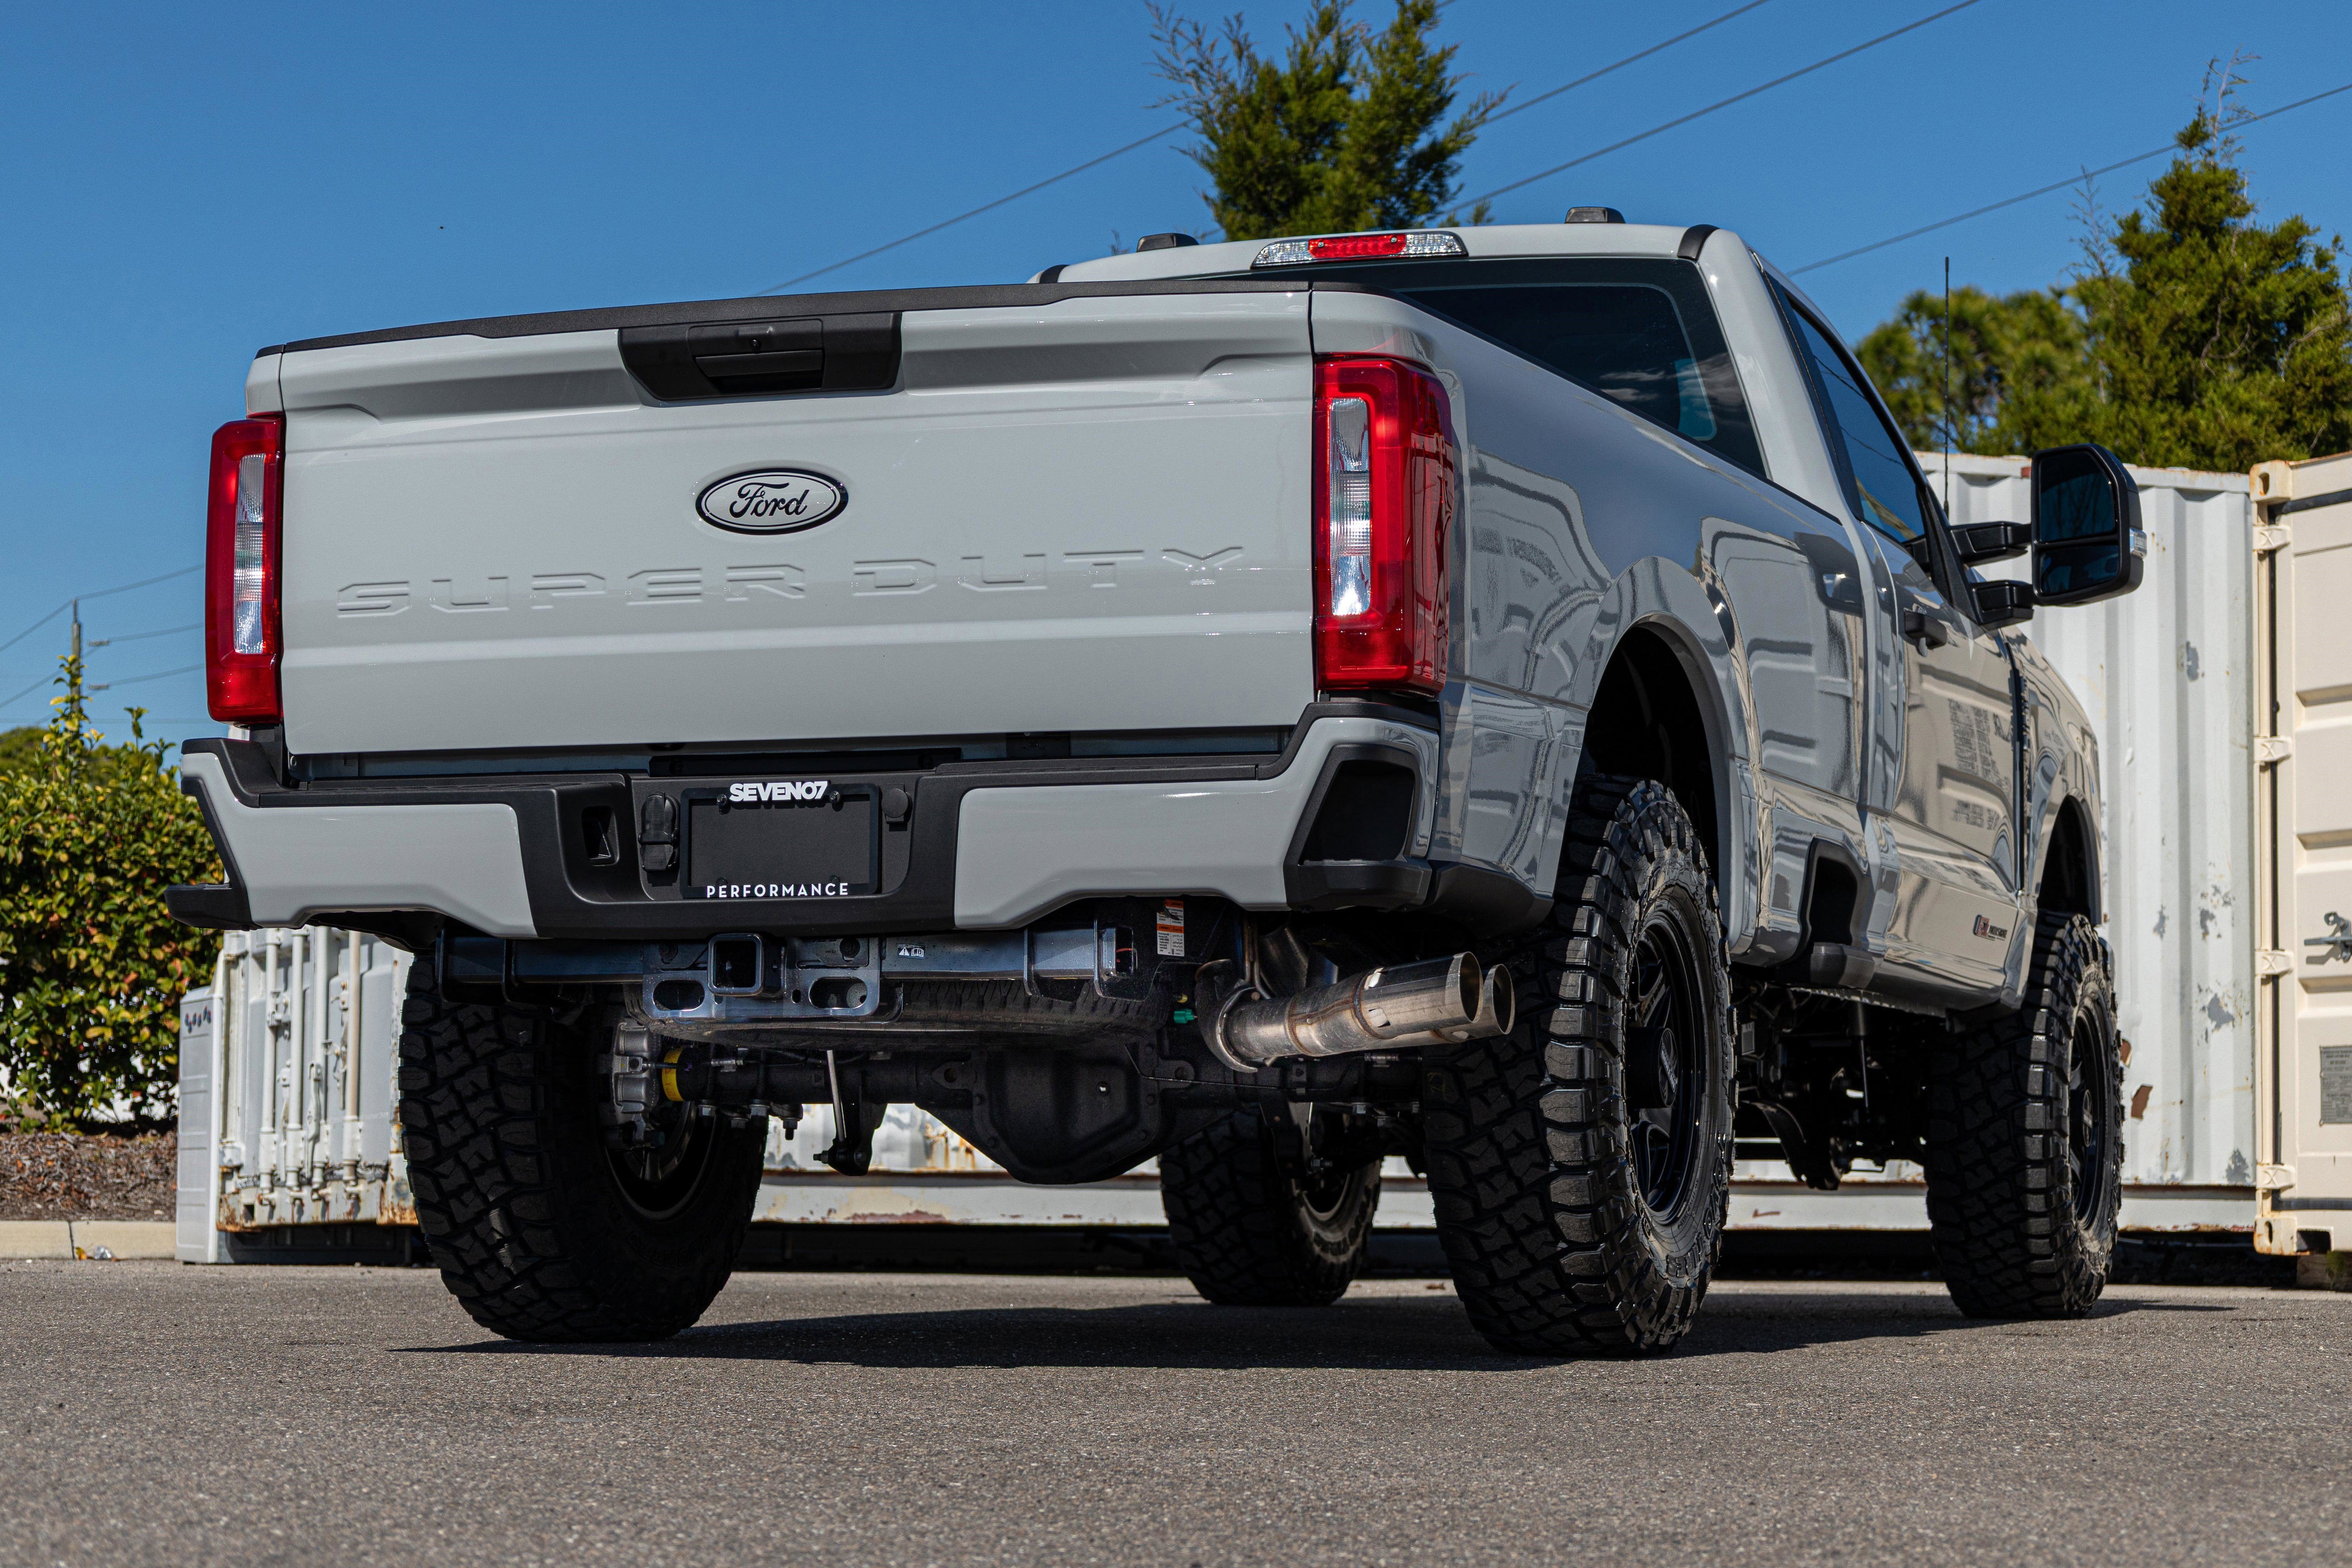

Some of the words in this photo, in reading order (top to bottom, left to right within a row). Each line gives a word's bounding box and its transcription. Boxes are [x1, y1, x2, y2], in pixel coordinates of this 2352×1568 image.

[729, 481, 811, 519] Ford
[337, 564, 806, 618] SUPER
[852, 545, 1244, 597] DUTY
[706, 882, 849, 898] PERFORMANCE
[1702, 1132, 1726, 1240] TOYO
[1666, 1231, 1706, 1277] TIRES
